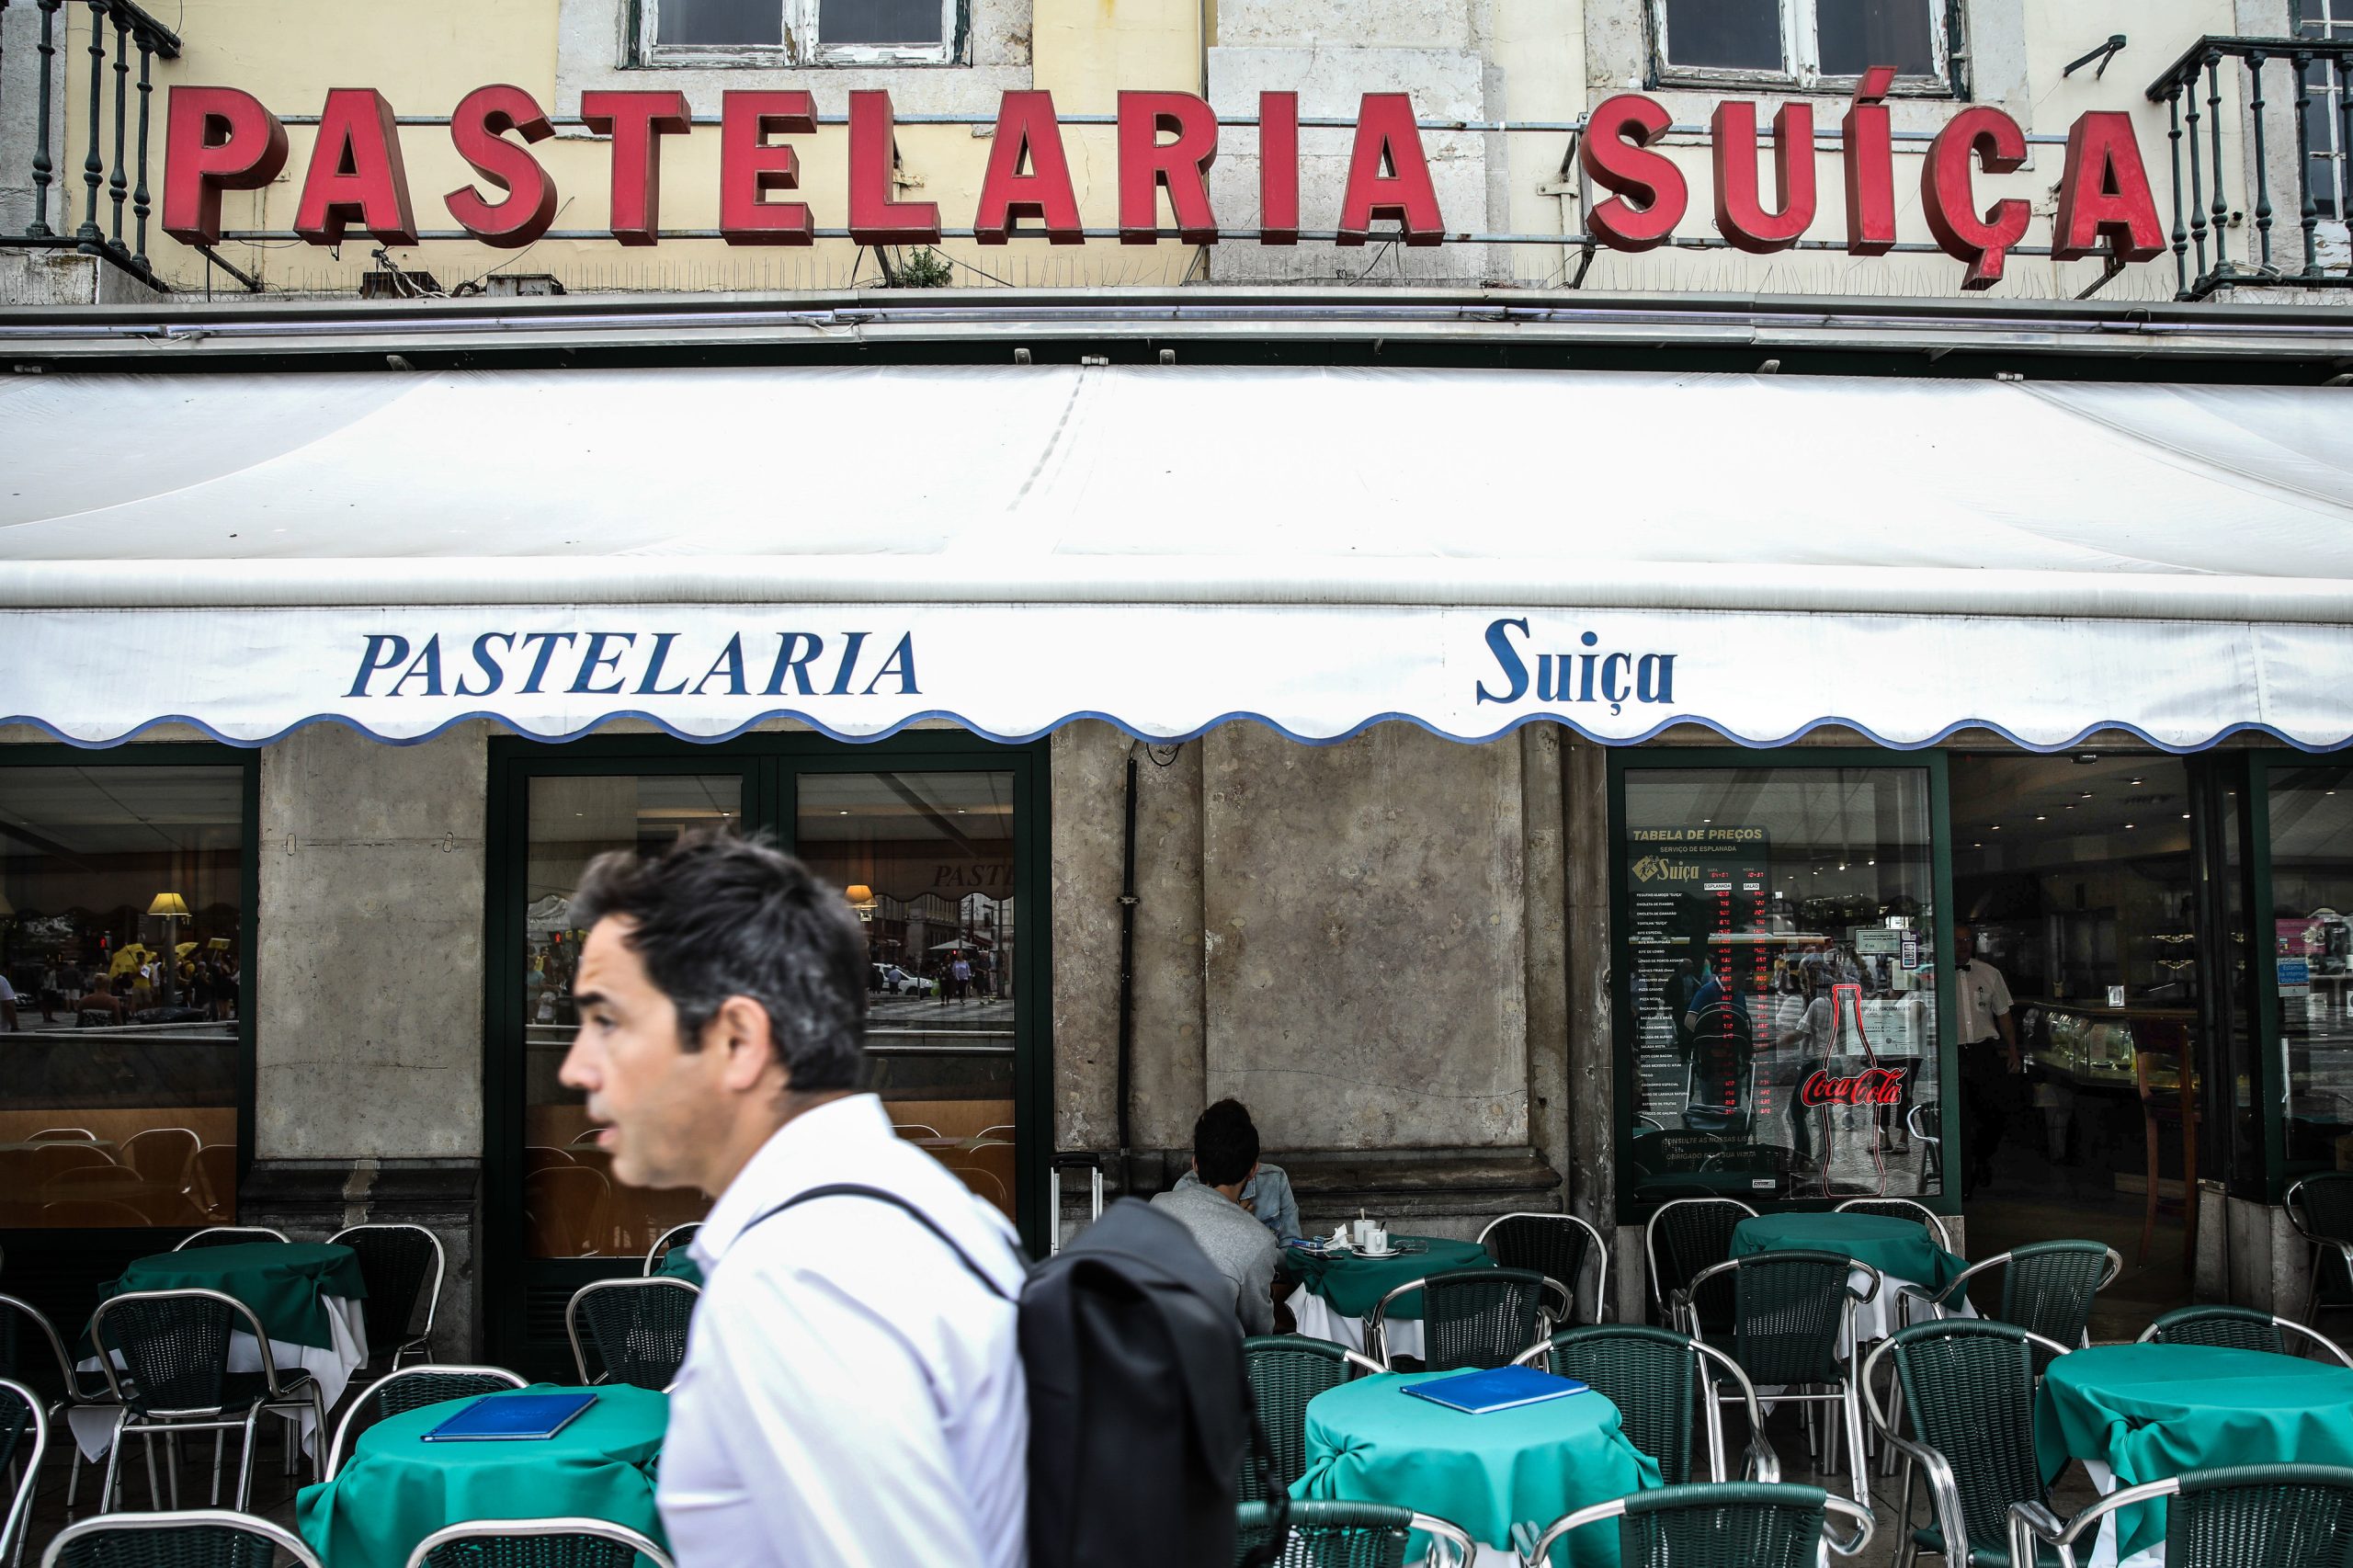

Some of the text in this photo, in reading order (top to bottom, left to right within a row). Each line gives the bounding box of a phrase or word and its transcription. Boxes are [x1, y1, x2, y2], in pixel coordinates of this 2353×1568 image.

[161, 65, 2166, 290] PASTELARIA SUÍÇA
[341, 617, 1678, 716] PASTELARIA Suiça
[1632, 829, 1762, 842] TABELA DE PREÇOS
[1656, 858, 1699, 882] Suiça
[1802, 1067, 1907, 1107] Coca-Cola
